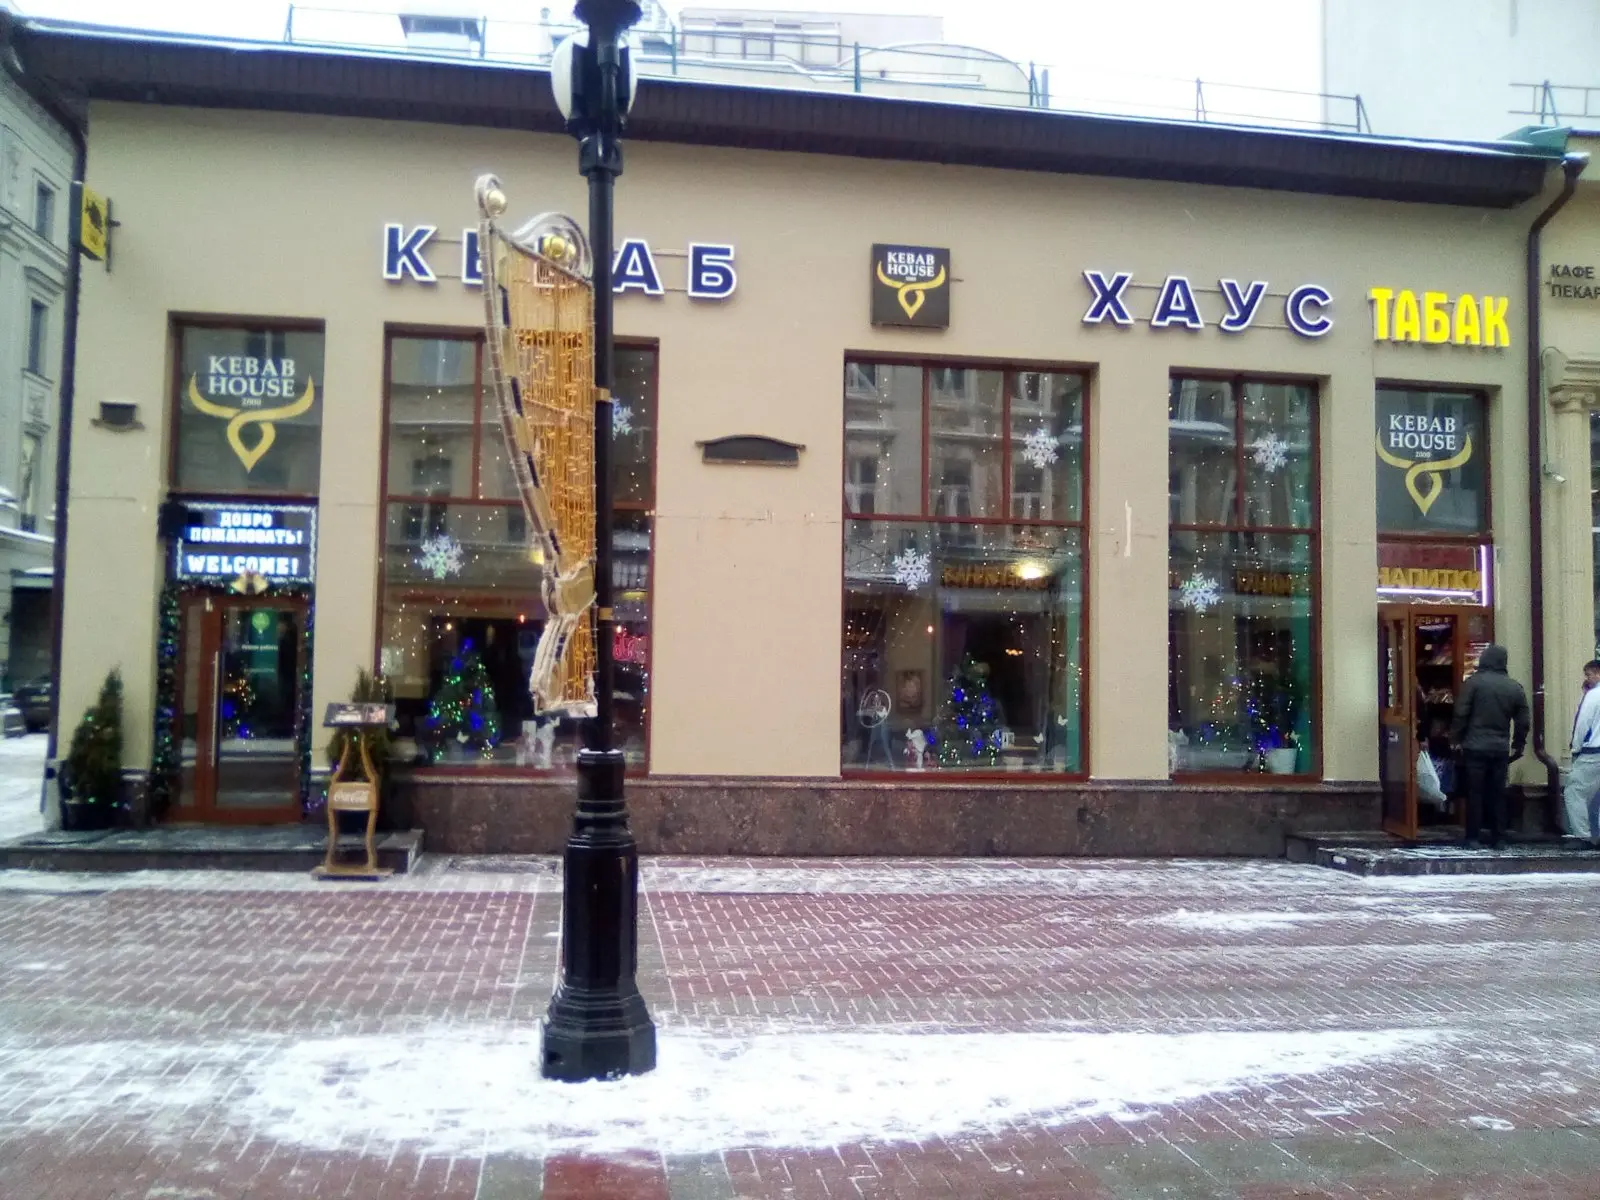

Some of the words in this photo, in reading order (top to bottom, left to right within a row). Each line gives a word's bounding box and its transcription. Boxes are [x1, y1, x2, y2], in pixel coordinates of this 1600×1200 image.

[887, 251, 935, 266] KEBAB
[887, 263, 935, 277] HOUSE
[1551, 264, 1595, 279] КАФЕ
[1083, 270, 1334, 337] ХАУС
[1368, 287, 1510, 347] ТАБАК
[208, 356, 296, 377] KEBAB
[208, 376, 296, 397] HOUSE
[1389, 415, 1456, 433] KEBAB
[1389, 432, 1456, 450] HOUSE
[220, 512, 273, 528] ДОБРО
[187, 555, 299, 576] WELCOME!
